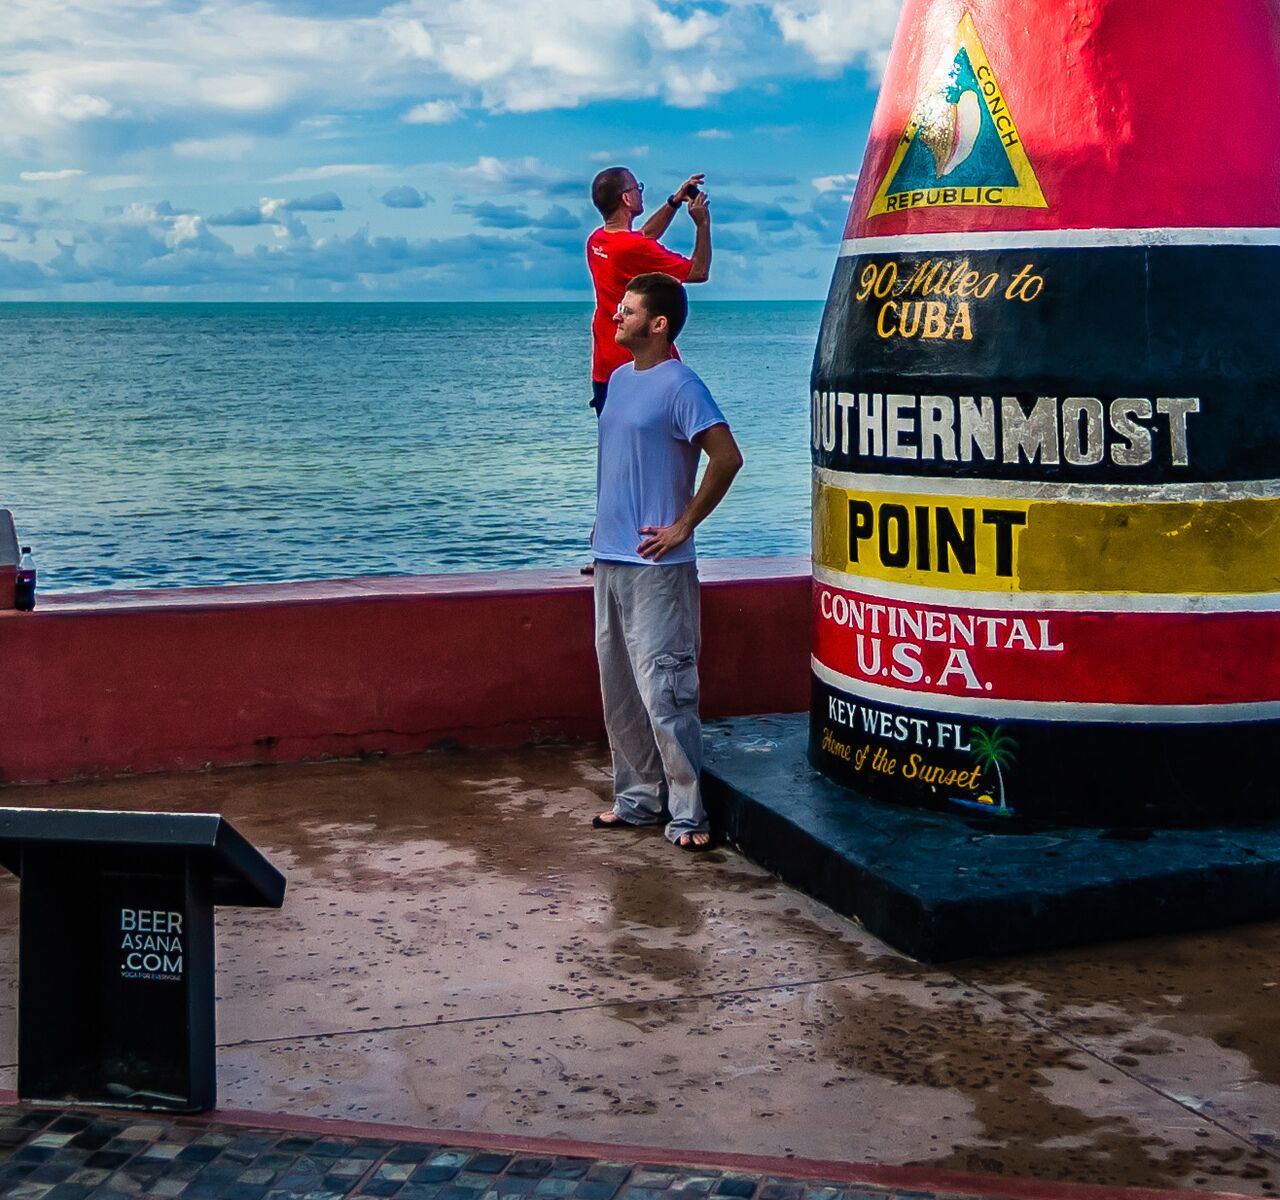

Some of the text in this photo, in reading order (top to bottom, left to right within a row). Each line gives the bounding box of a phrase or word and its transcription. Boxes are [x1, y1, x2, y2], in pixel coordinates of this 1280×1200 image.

[977, 65, 1018, 148] CONCH
[886, 188, 1003, 211] REPUBLIC
[856, 259, 1044, 302] 90 Miles to
[877, 300, 973, 340] CUBA
[848, 500, 1026, 577] POINT
[821, 591, 1064, 651] CONTINENTAL
[856, 634, 993, 690] U.S.A.
[829, 696, 856, 728] KEY
[822, 727, 982, 789] Home of the Sunset
[121, 908, 183, 934] BEER
[121, 933, 183, 953] ASANA
[121, 952, 183, 973] .COM
